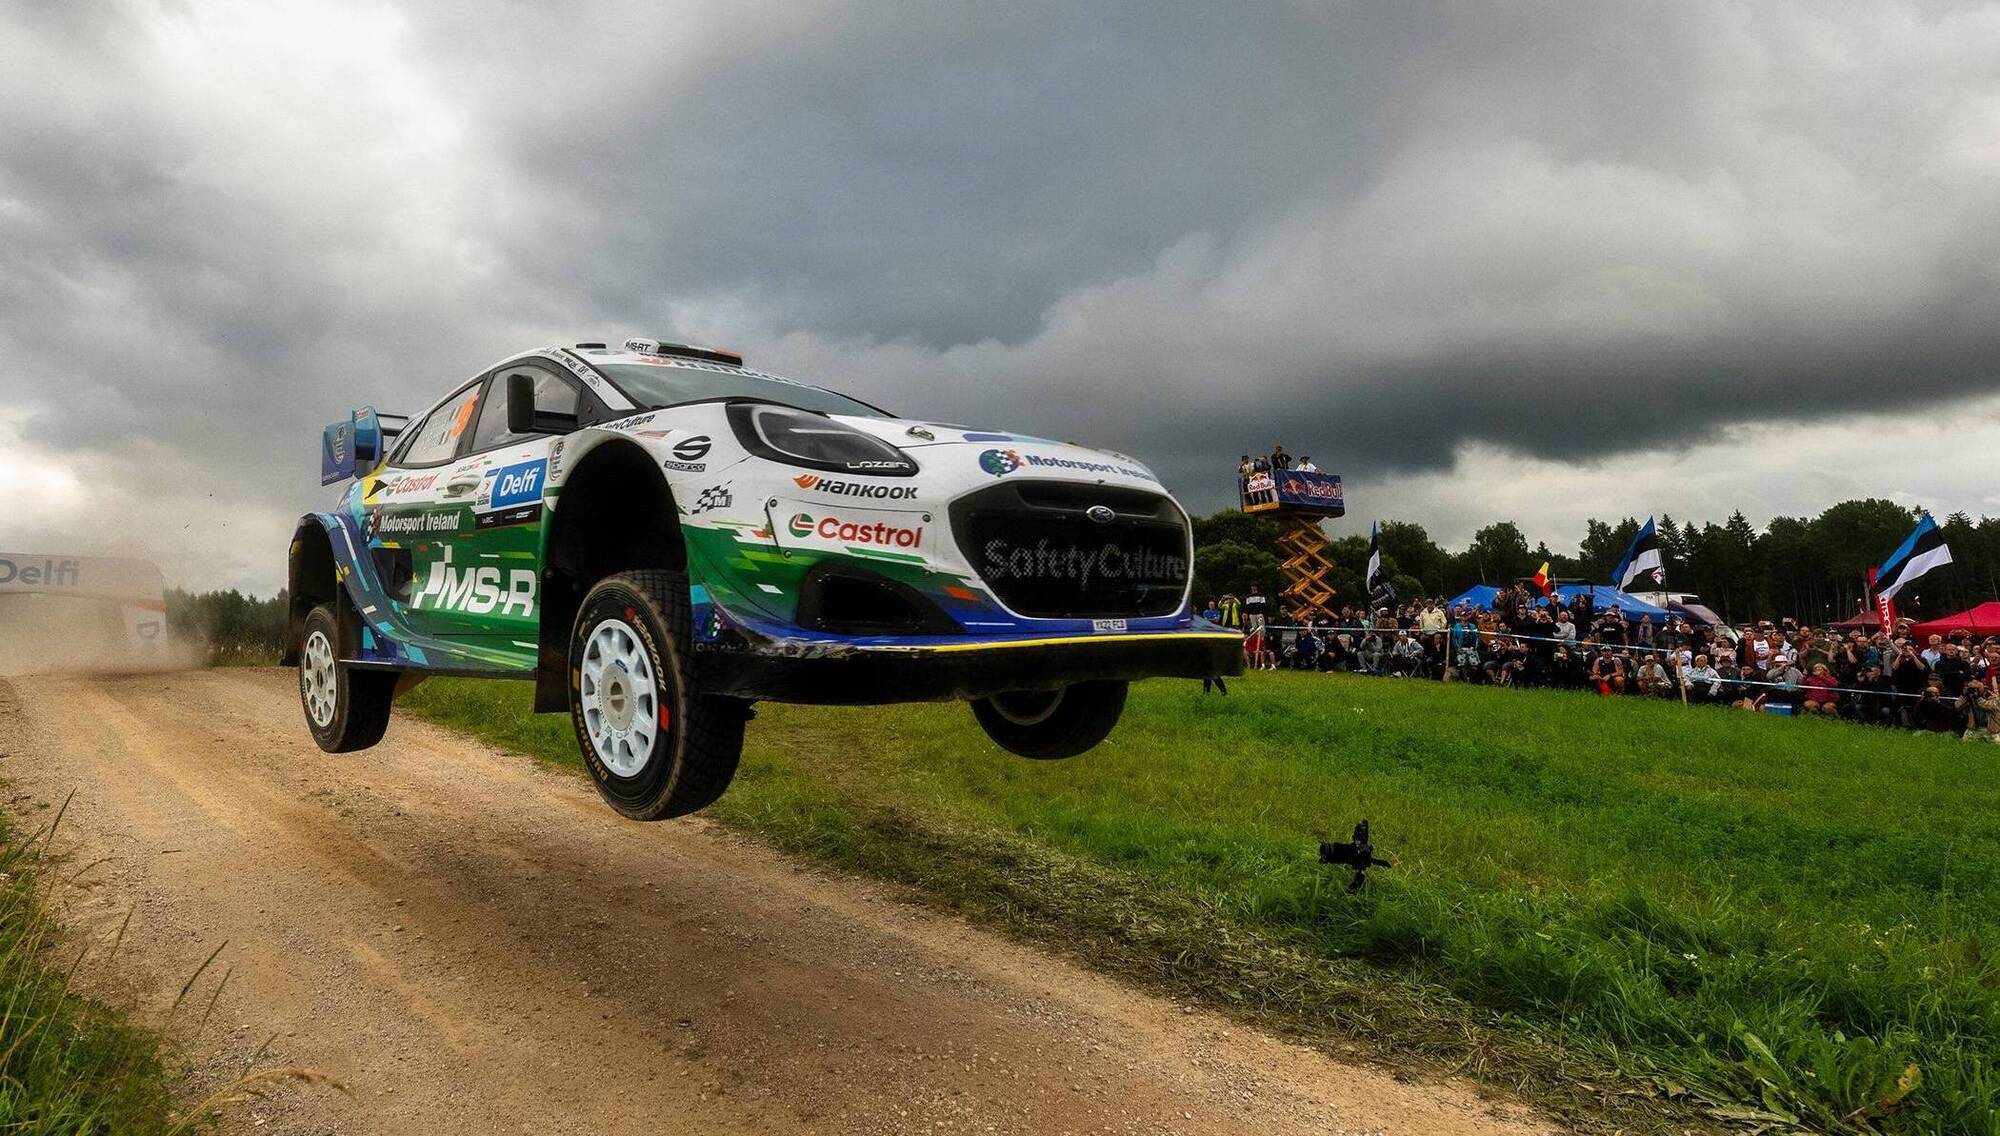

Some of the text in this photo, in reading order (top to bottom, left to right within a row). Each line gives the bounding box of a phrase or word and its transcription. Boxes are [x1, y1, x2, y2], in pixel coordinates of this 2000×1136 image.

[1025, 455, 1117, 473] Motorsport
[396, 472, 440, 494] Castrol
[500, 467, 540, 497] Delfi
[1306, 480, 1325, 498] Red
[379, 511, 461, 534] Motorsport Ireland
[818, 517, 922, 548] Castrol
[0, 559, 80, 586] Delfi
[985, 538, 1185, 590] SafetyCulture
